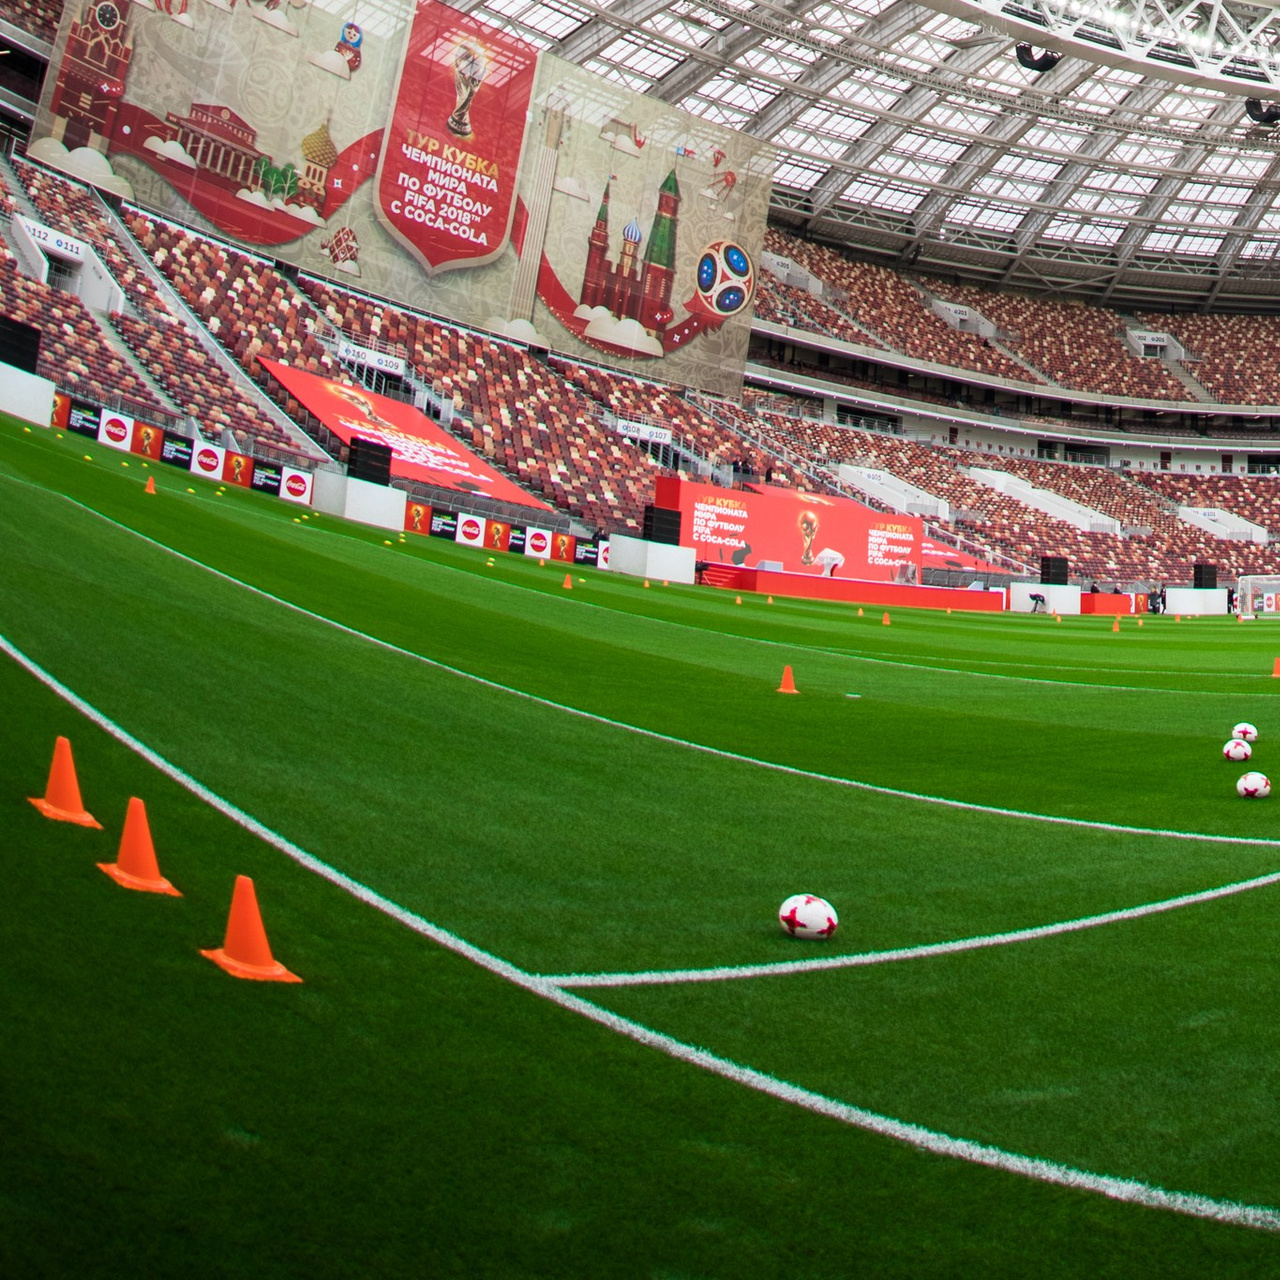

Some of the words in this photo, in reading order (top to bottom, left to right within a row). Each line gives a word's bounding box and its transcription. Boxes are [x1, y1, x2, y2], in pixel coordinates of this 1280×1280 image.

[406, 128, 440, 152] ТУР
[442, 144, 499, 179] КУБКА
[402, 143, 498, 192] ЧЕМПИОНАТА
[428, 169, 467, 195] МИРА
[398, 172, 420, 191] ПО
[423, 183, 492, 217] ФУТБОЛУ
[404, 190, 436, 212] FIFA
[404, 205, 488, 246] COCA-COLA
[32, 228, 48, 241] 112
[64, 241, 80, 255] 111
[694, 502, 748, 519] ЧЕМПИОНАТА
[716, 497, 747, 509] КУБКА
[693, 518, 706, 526] ПО
[707, 520, 745, 532] ФУТБОЛУ
[694, 510, 717, 521] МИРА
[700, 534, 746, 548] COCA-COLA
[868, 529, 914, 541] ЧЕМПИОНАТА
[880, 544, 912, 554] ФУТБОЛУ
